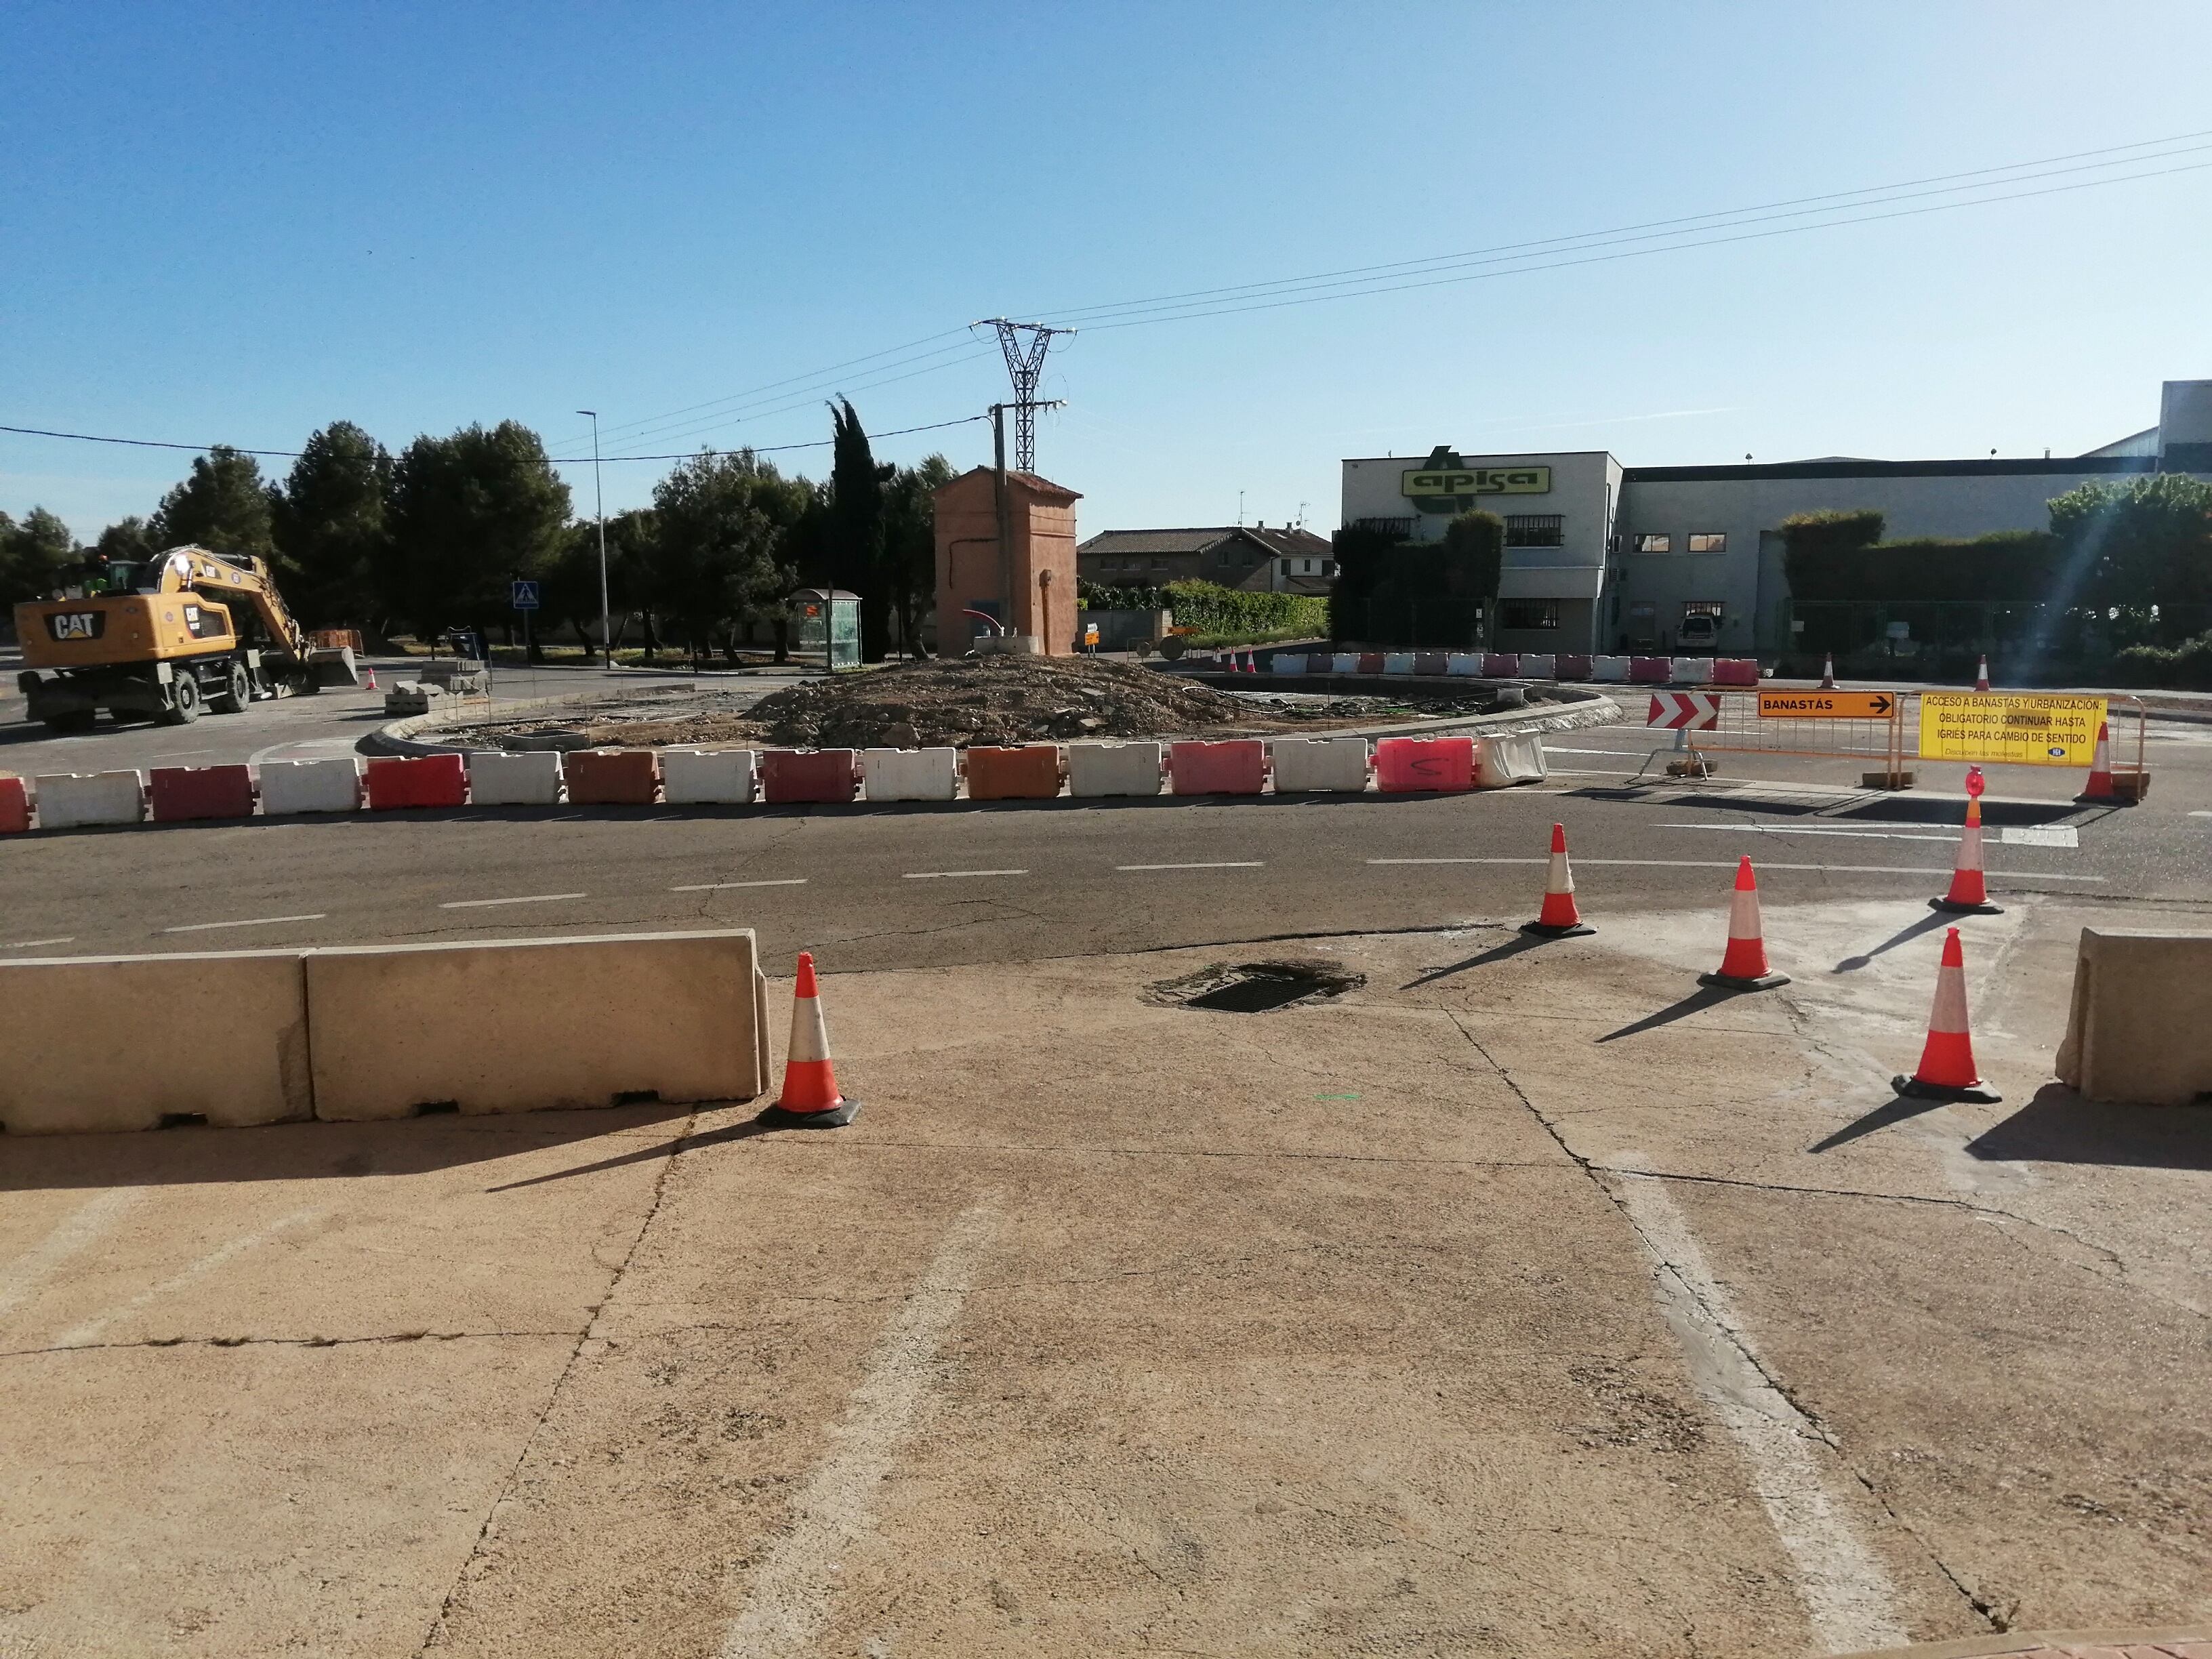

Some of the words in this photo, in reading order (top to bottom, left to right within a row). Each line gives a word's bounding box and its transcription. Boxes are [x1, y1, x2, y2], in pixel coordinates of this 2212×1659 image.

[1413, 470, 1538, 493] apisa
[54, 613, 94, 639] CAT
[1763, 698, 1833, 710] BANASTÁS
[1926, 696, 1963, 707] ACCESO
[1963, 697, 1970, 707] A
[2023, 699, 2029, 708] Y
[2030, 698, 2102, 710] URBANIZACIÓN:
[1939, 713, 1999, 724] OBLIGATORIO
[2001, 714, 2053, 726] CONTINUAR
[2055, 716, 2086, 727] HASTA
[1937, 727, 1965, 739] IGRIÉS
[1968, 729, 1992, 740] PARA
[1994, 731, 2029, 741] CAMBIO
[2031, 733, 2043, 743] DE
[2046, 733, 2086, 743] SENTIDO
[1990, 750, 2024, 758] molestias
